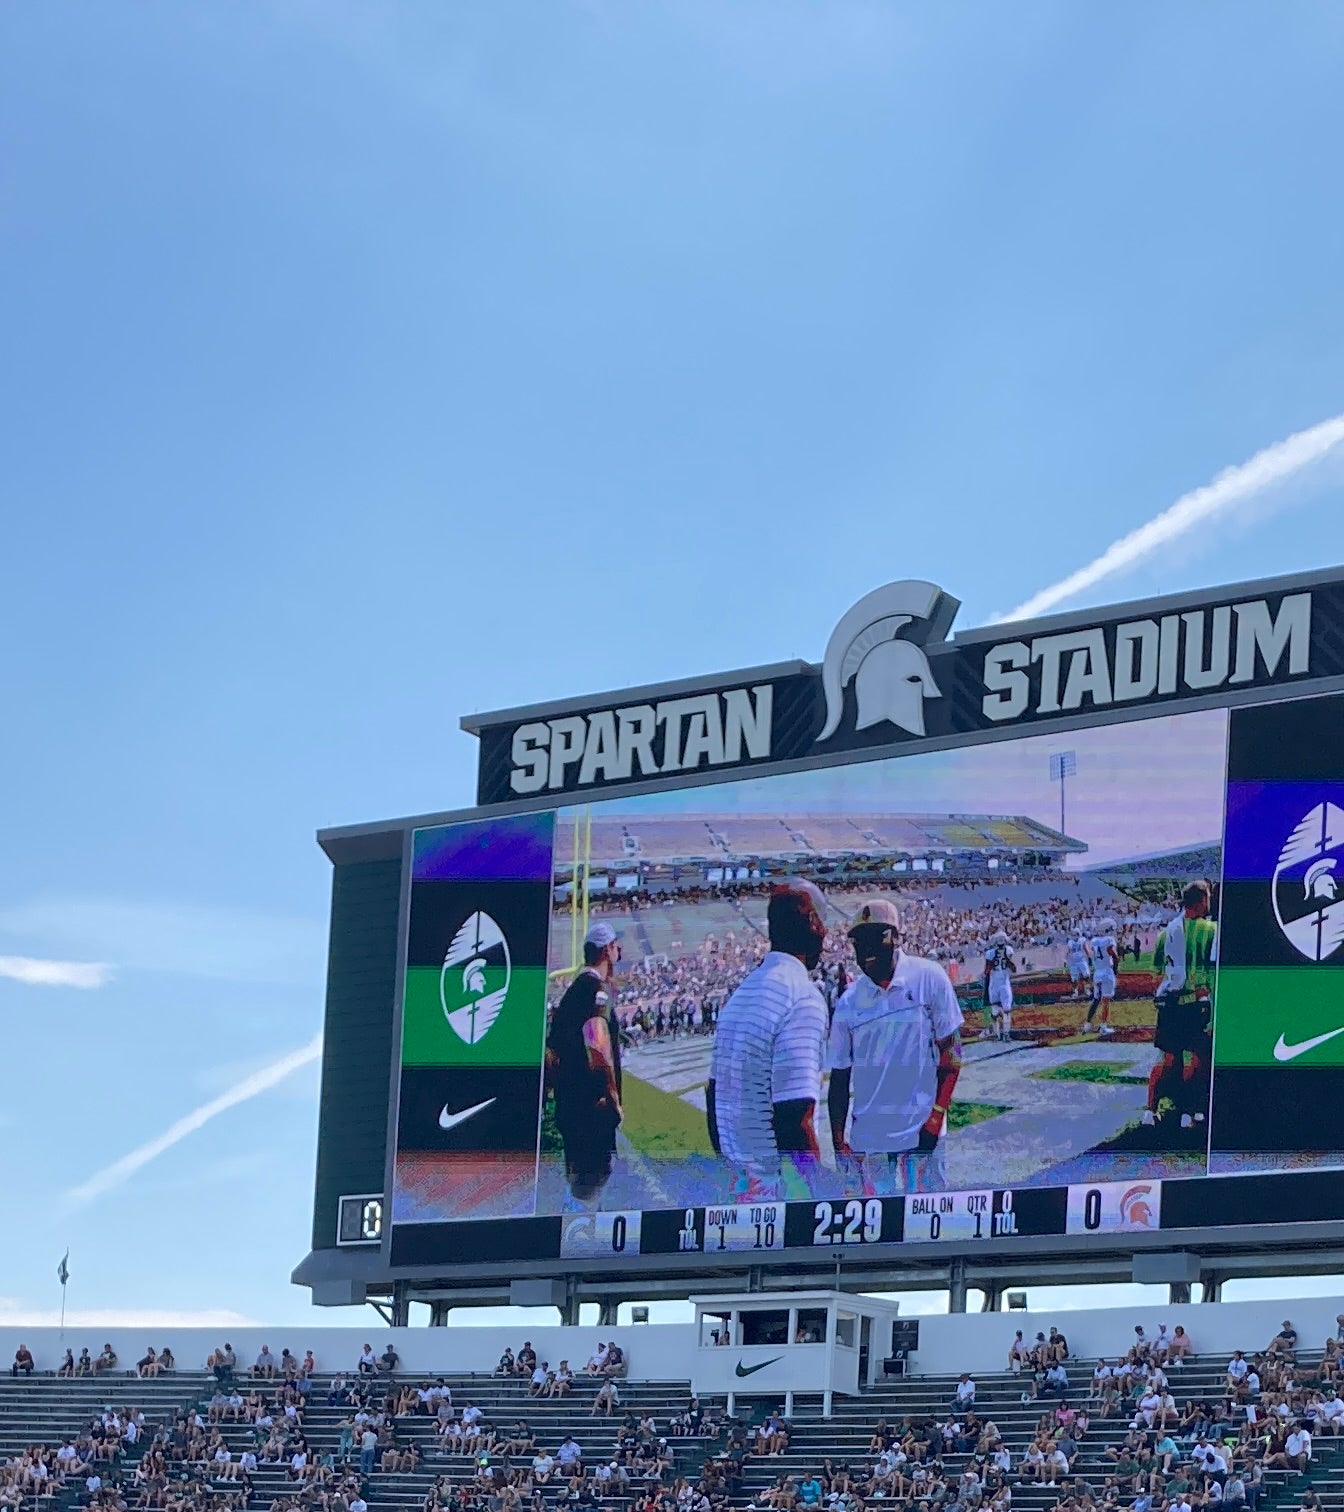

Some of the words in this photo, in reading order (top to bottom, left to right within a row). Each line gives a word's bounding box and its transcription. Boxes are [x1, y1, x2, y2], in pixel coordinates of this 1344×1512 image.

[510, 685, 774, 794] SPARTAN
[982, 592, 1312, 721] STADIUM
[709, 1209, 737, 1226] DOWN
[750, 1207, 762, 1224] TO
[764, 1206, 777, 1223] GO
[912, 1198, 936, 1215] BALL
[940, 1197, 954, 1213] ON
[967, 1195, 987, 1213] QTR
[1085, 1190, 1102, 1230] 0
[363, 1201, 381, 1238] 0
[813, 1199, 883, 1245] 2:29
[931, 1214, 941, 1239] 0
[973, 1212, 982, 1238] 1
[995, 1212, 1019, 1234] TOL
[612, 1215, 627, 1252] 0
[679, 1229, 699, 1250] TOL
[718, 1226, 726, 1249] 1
[753, 1223, 775, 1248] 10
